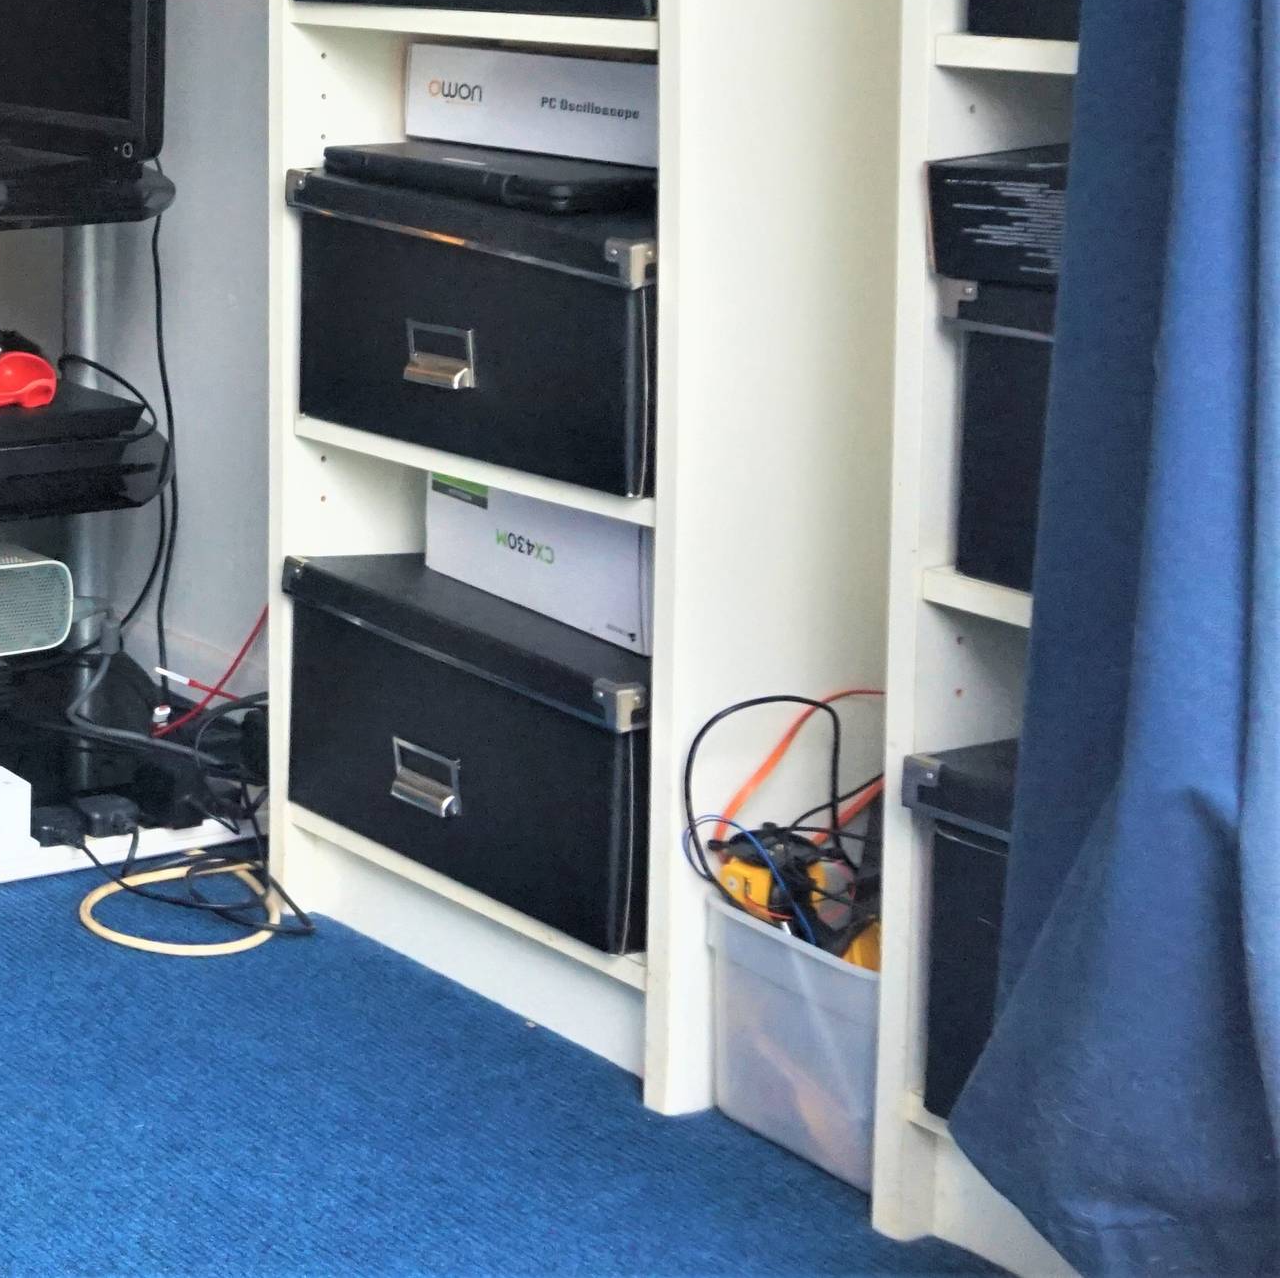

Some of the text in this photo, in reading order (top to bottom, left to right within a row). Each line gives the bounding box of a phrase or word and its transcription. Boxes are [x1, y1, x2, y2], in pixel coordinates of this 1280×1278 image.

[540, 95, 640, 121] PC Oscilloscope
[495, 528, 556, 565] CX430M
